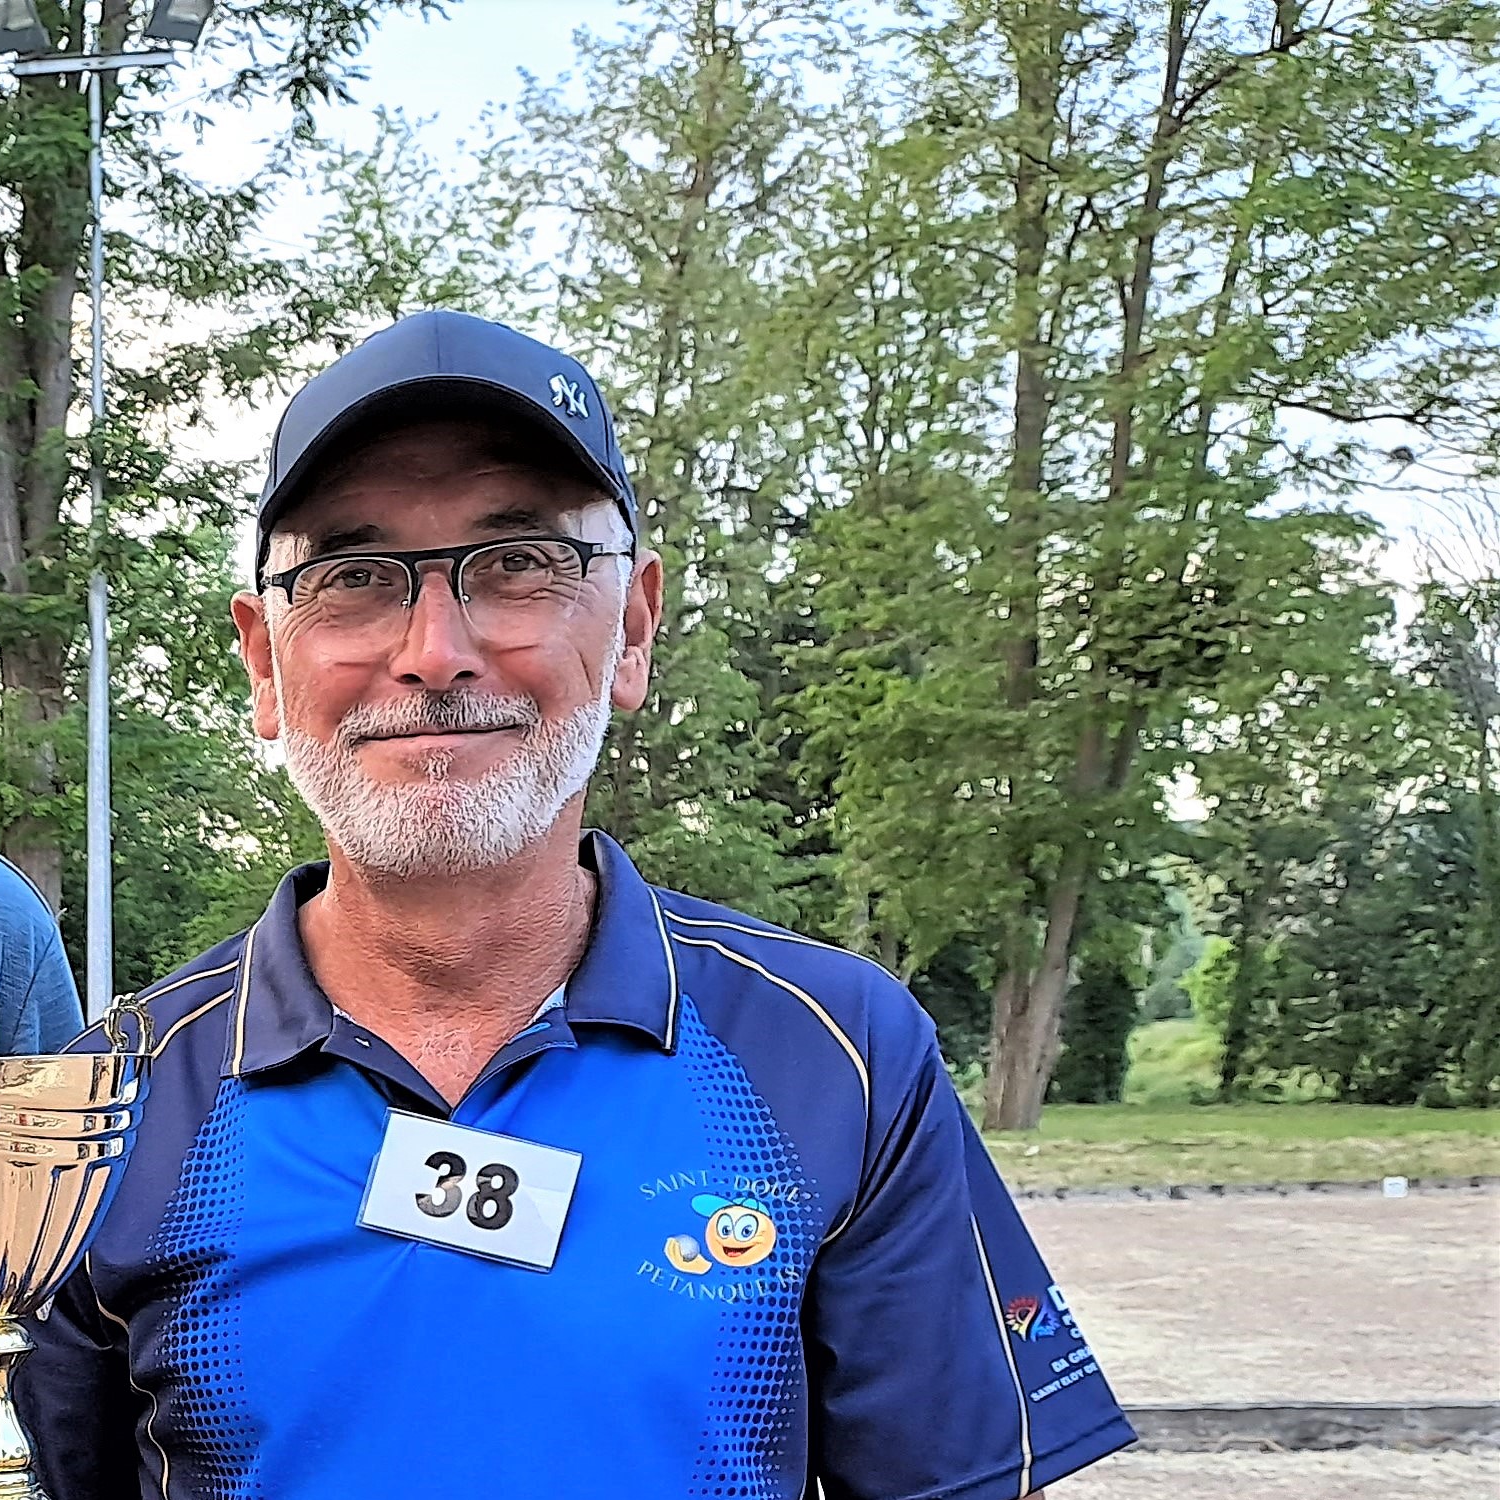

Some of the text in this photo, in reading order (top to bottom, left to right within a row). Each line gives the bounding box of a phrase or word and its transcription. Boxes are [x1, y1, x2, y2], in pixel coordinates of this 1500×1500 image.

[415, 1150, 520, 1231] 38
[639, 1169, 709, 1201] SAINT
[636, 1260, 771, 1304] PETANQUE
